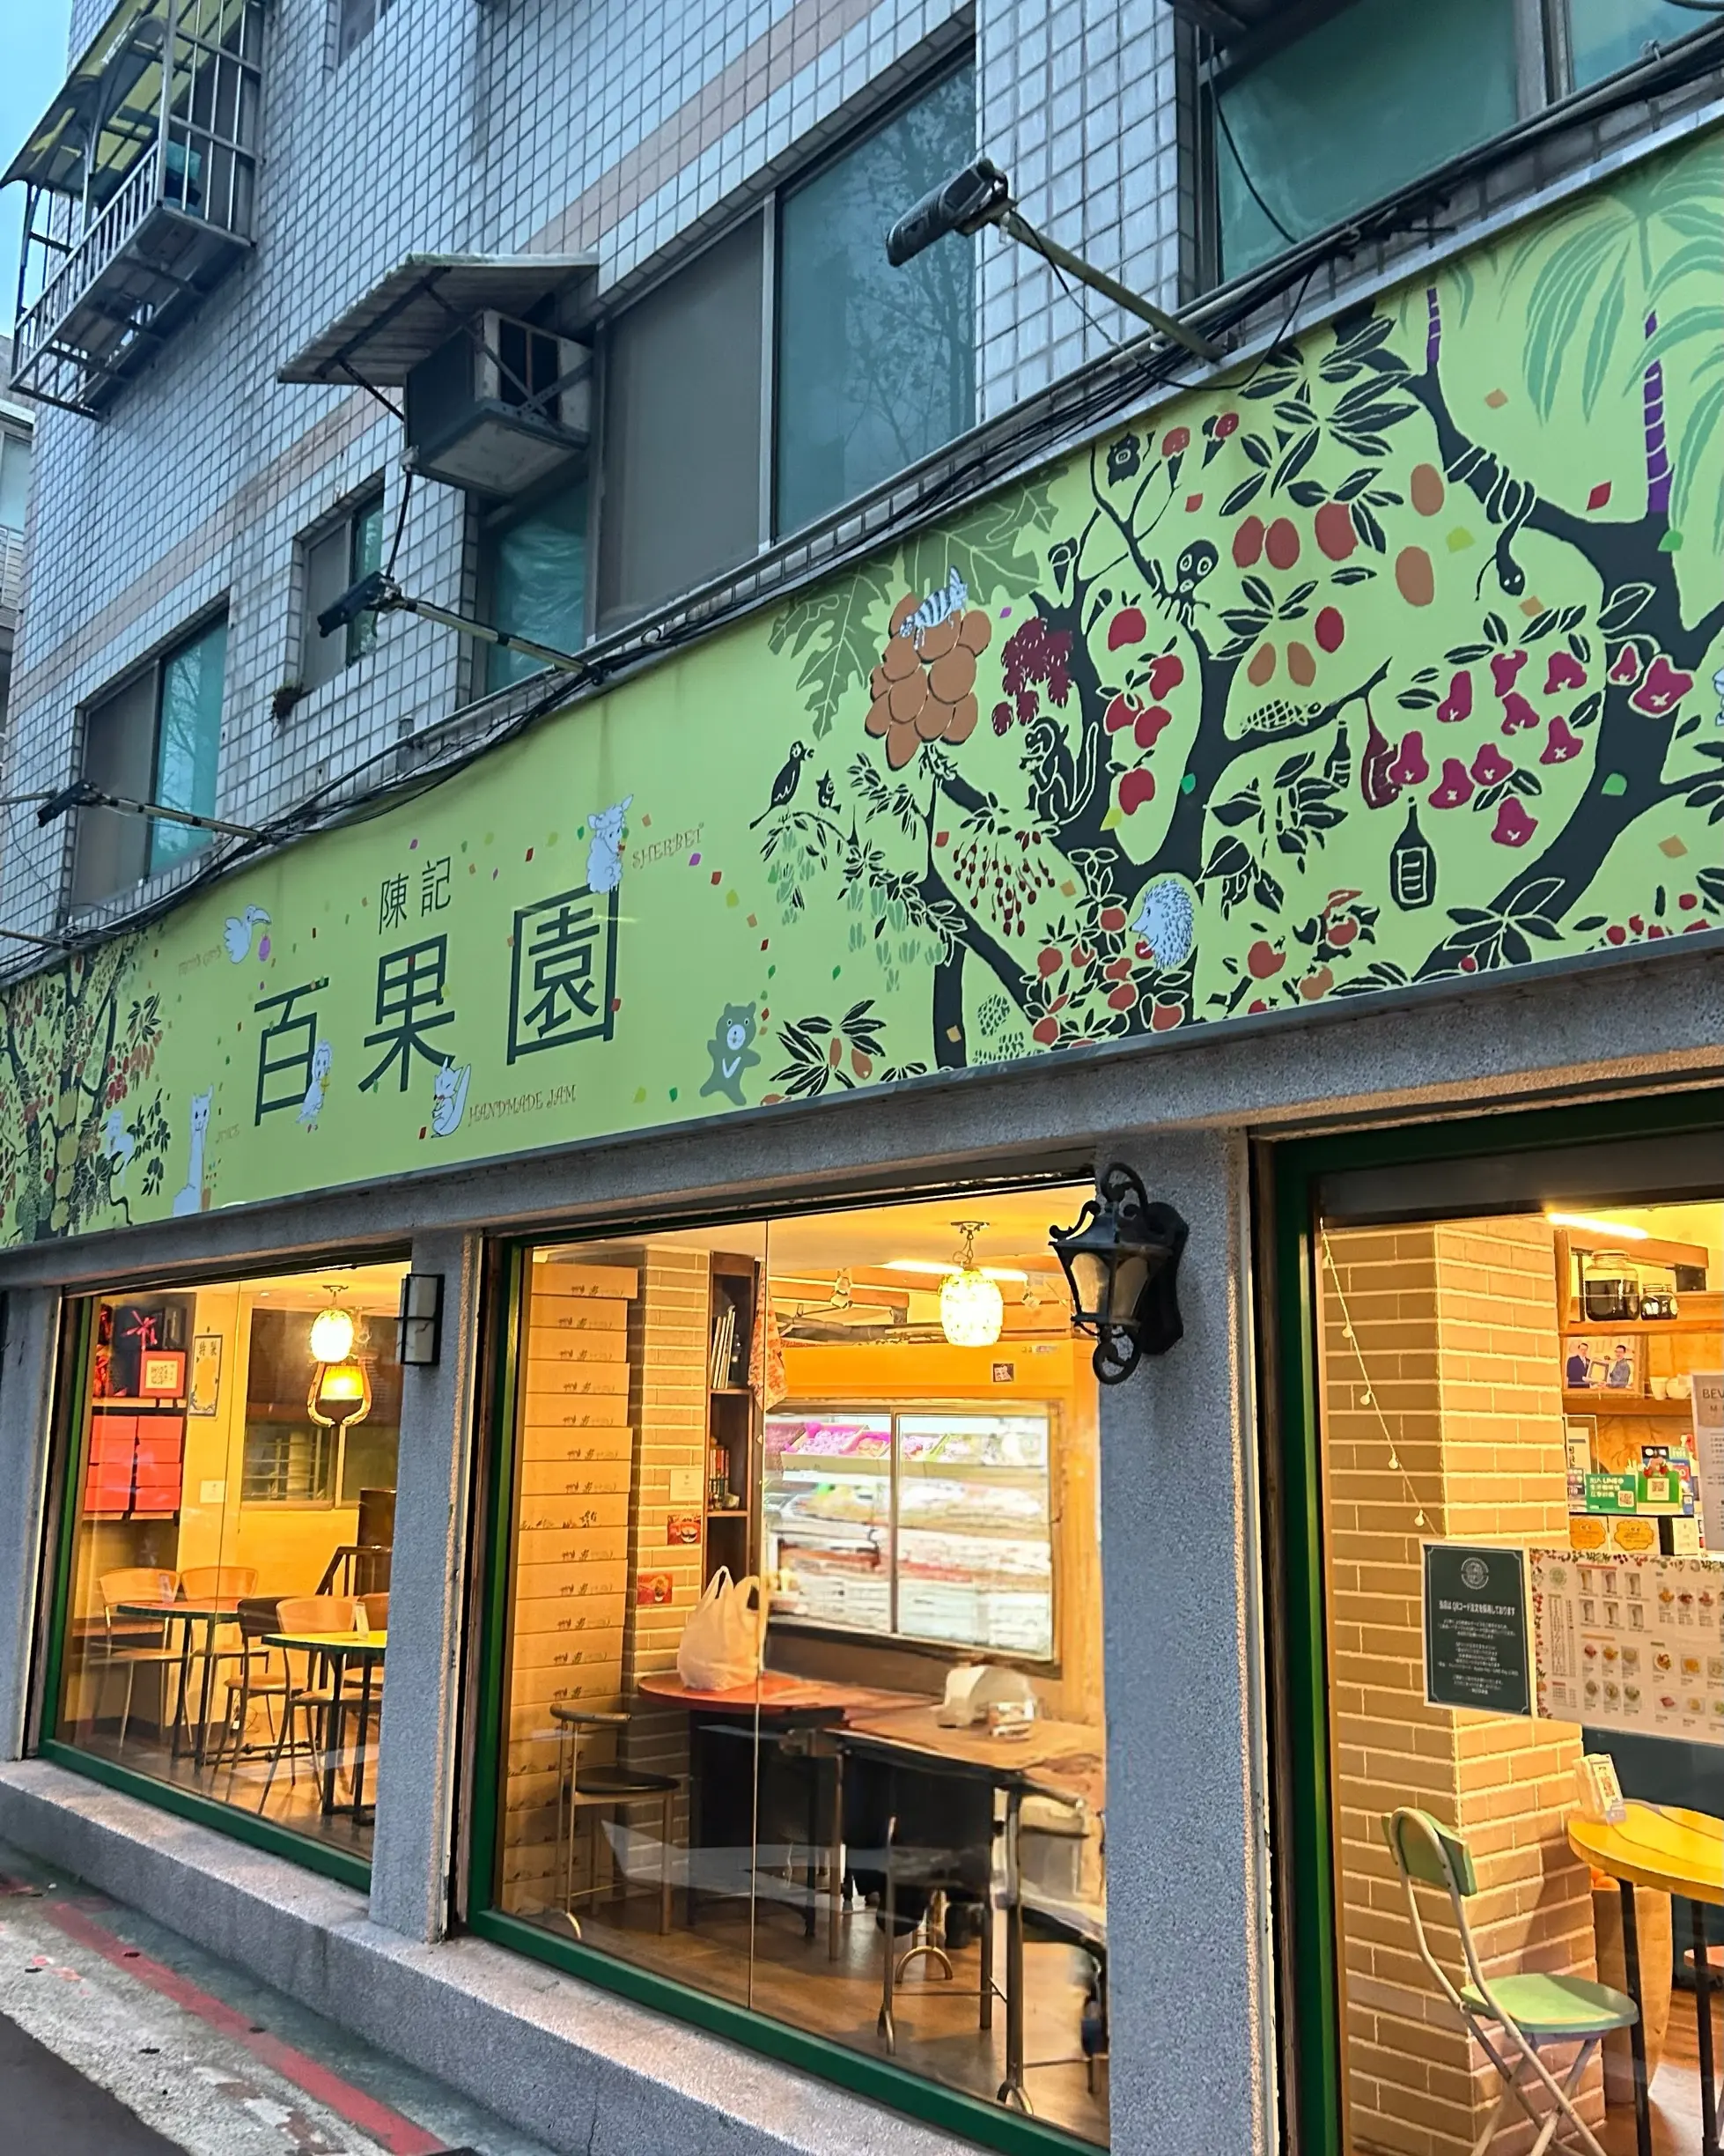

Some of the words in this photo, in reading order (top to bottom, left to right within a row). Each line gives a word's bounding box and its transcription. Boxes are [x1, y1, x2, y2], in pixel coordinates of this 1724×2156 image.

[632, 822, 704, 869] SHERBET
[379, 856, 451, 935] 陳記
[254, 882, 619, 1127] 百果園
[468, 1090, 543, 1127] HANDMADE
[546, 1084, 577, 1109] JAM
